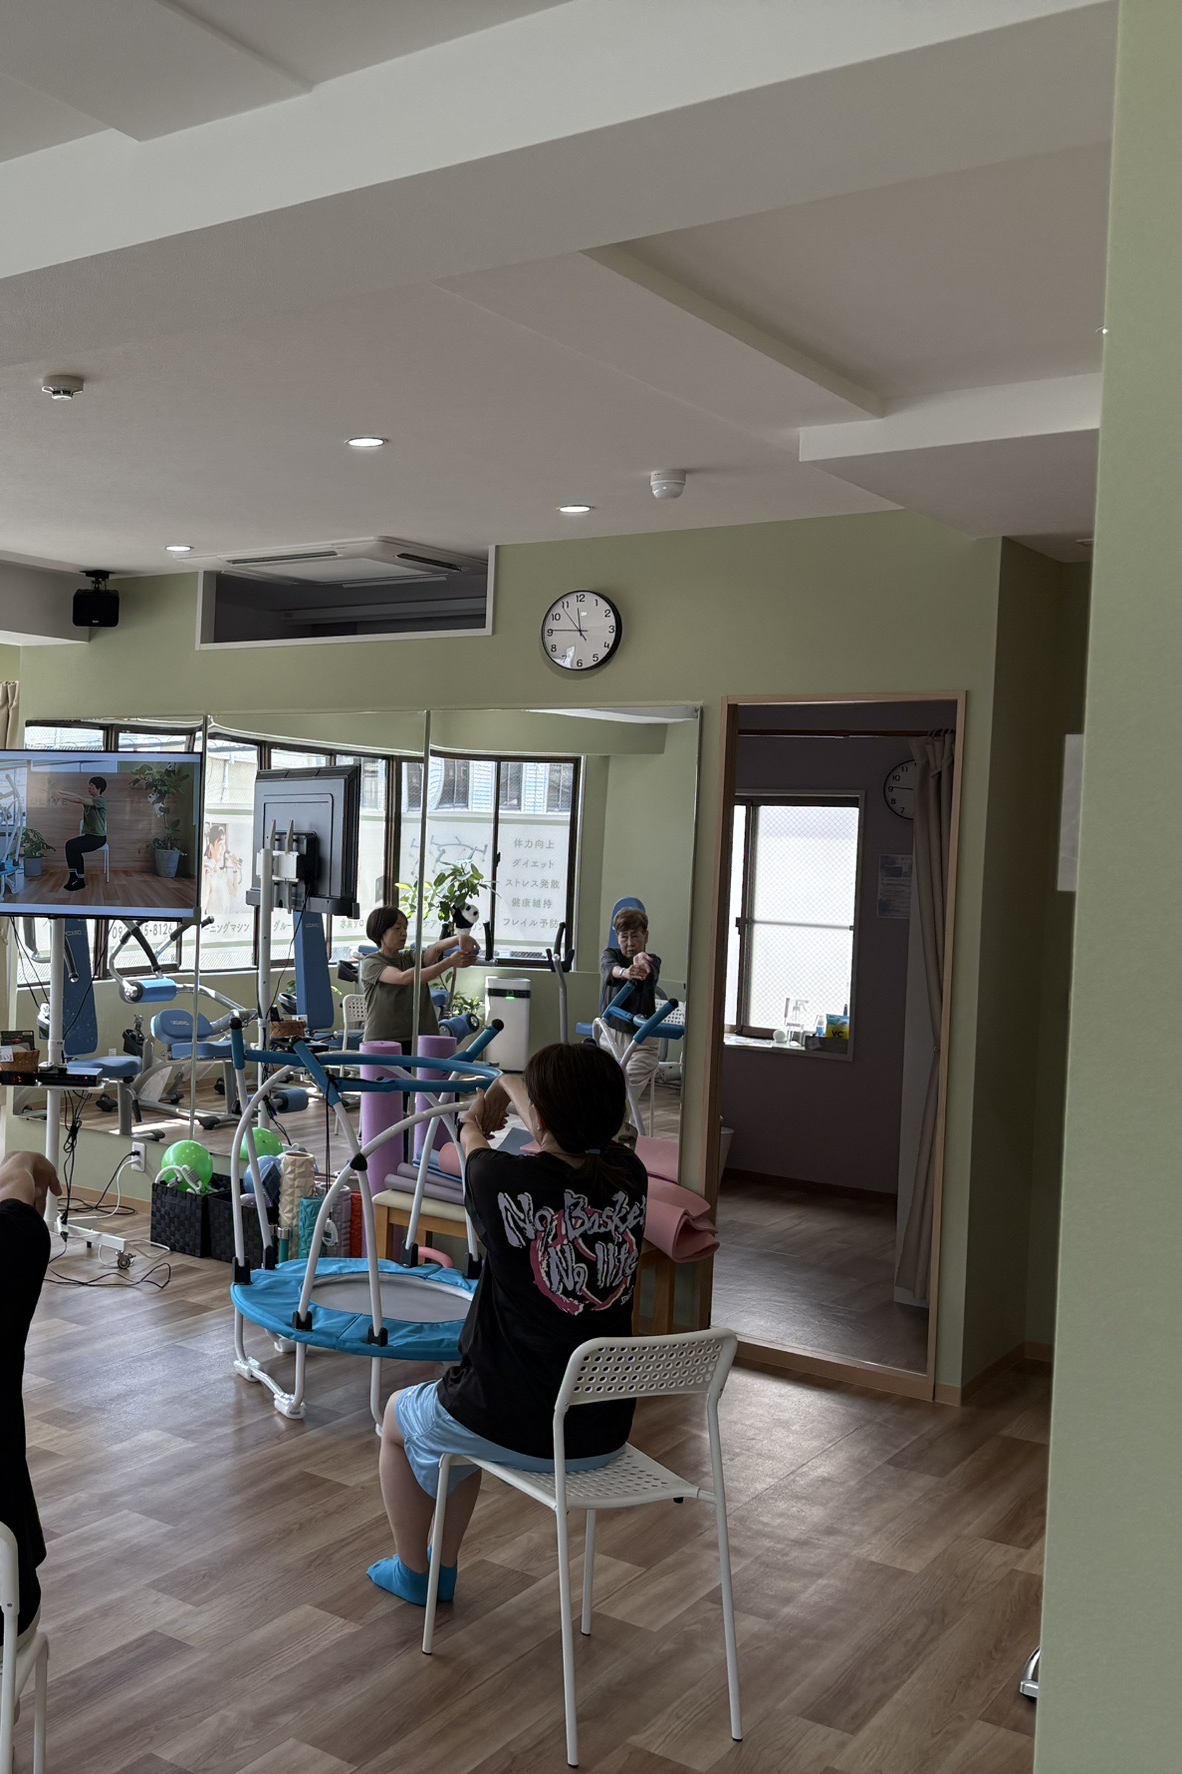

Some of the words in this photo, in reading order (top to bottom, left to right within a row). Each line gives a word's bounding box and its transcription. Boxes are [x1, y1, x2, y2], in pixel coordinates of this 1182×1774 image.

[575, 594, 586, 603] 12
[594, 599, 599, 607] 1
[561, 601, 570, 609] 11
[551, 613, 561, 622] 10
[604, 609, 611, 618] 2
[546, 629, 554, 637] 9
[608, 625, 615, 634] 3
[550, 644, 557, 653] 8
[561, 655, 568, 664] 7
[592, 654, 599, 662] 5
[576, 659, 583, 668] 6
[892, 774, 901, 782] 10
[887, 785, 894, 793] 9
[890, 797, 897, 805] 8
[899, 806, 905, 814] 7
[513, 837, 555, 850] 体力向上
[512, 858, 554, 870] ダイエット
[497, 1191, 555, 1249] No
[547, 1242, 589, 1295] No
